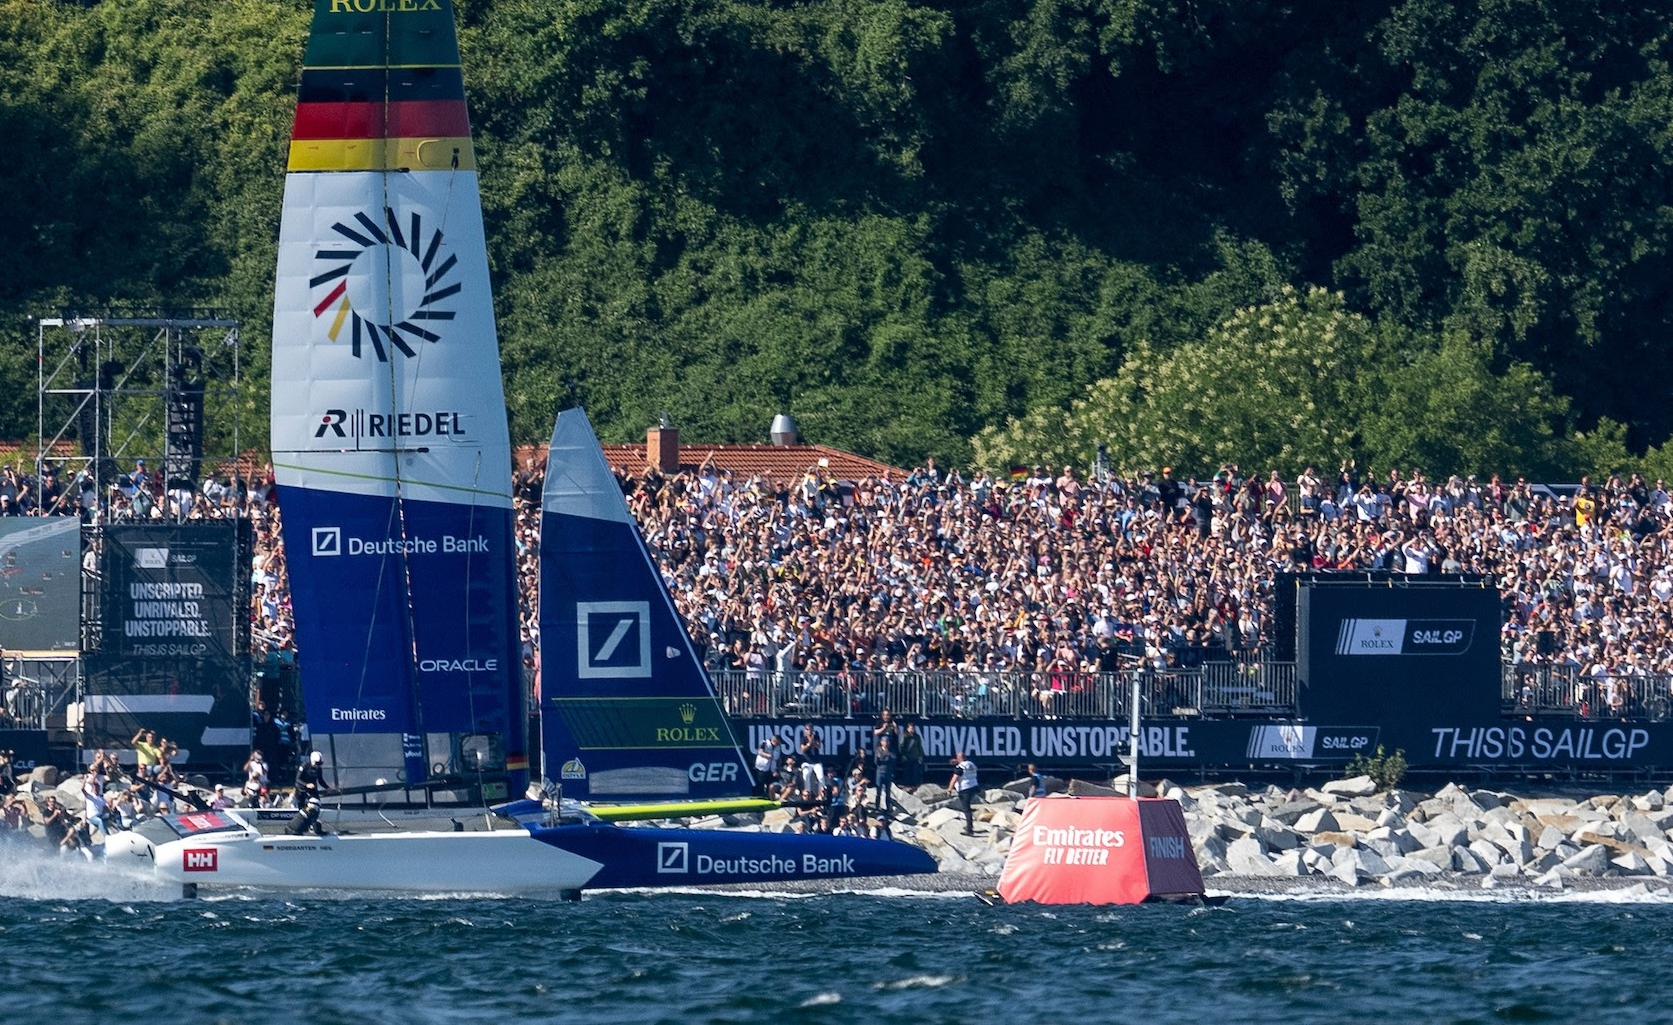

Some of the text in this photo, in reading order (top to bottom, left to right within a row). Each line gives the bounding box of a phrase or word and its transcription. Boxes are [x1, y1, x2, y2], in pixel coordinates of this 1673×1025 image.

[369, 412, 465, 437] RIEDEL
[348, 534, 489, 555] Deutsche Bank
[130, 582, 205, 600] UNSCRIPTED.
[134, 601, 202, 618] UNRIVALED.
[125, 620, 212, 637] UNSTOPPABLE.
[1360, 640, 1394, 649] ROLEX
[419, 659, 497, 672] ORACLE
[331, 708, 386, 721] Emirates
[656, 727, 721, 742] ROLEX
[1431, 727, 1505, 758] THIS
[1531, 728, 1649, 759] SAILGP
[1271, 744, 1306, 753] ROLEX
[689, 762, 739, 783] GER
[1031, 825, 1125, 848] Emirates
[1149, 836, 1185, 859] FINISH
[187, 852, 214, 868] HH
[697, 854, 855, 874] Deutsche Bank
[1043, 847, 1110, 867] FLY BETTER
